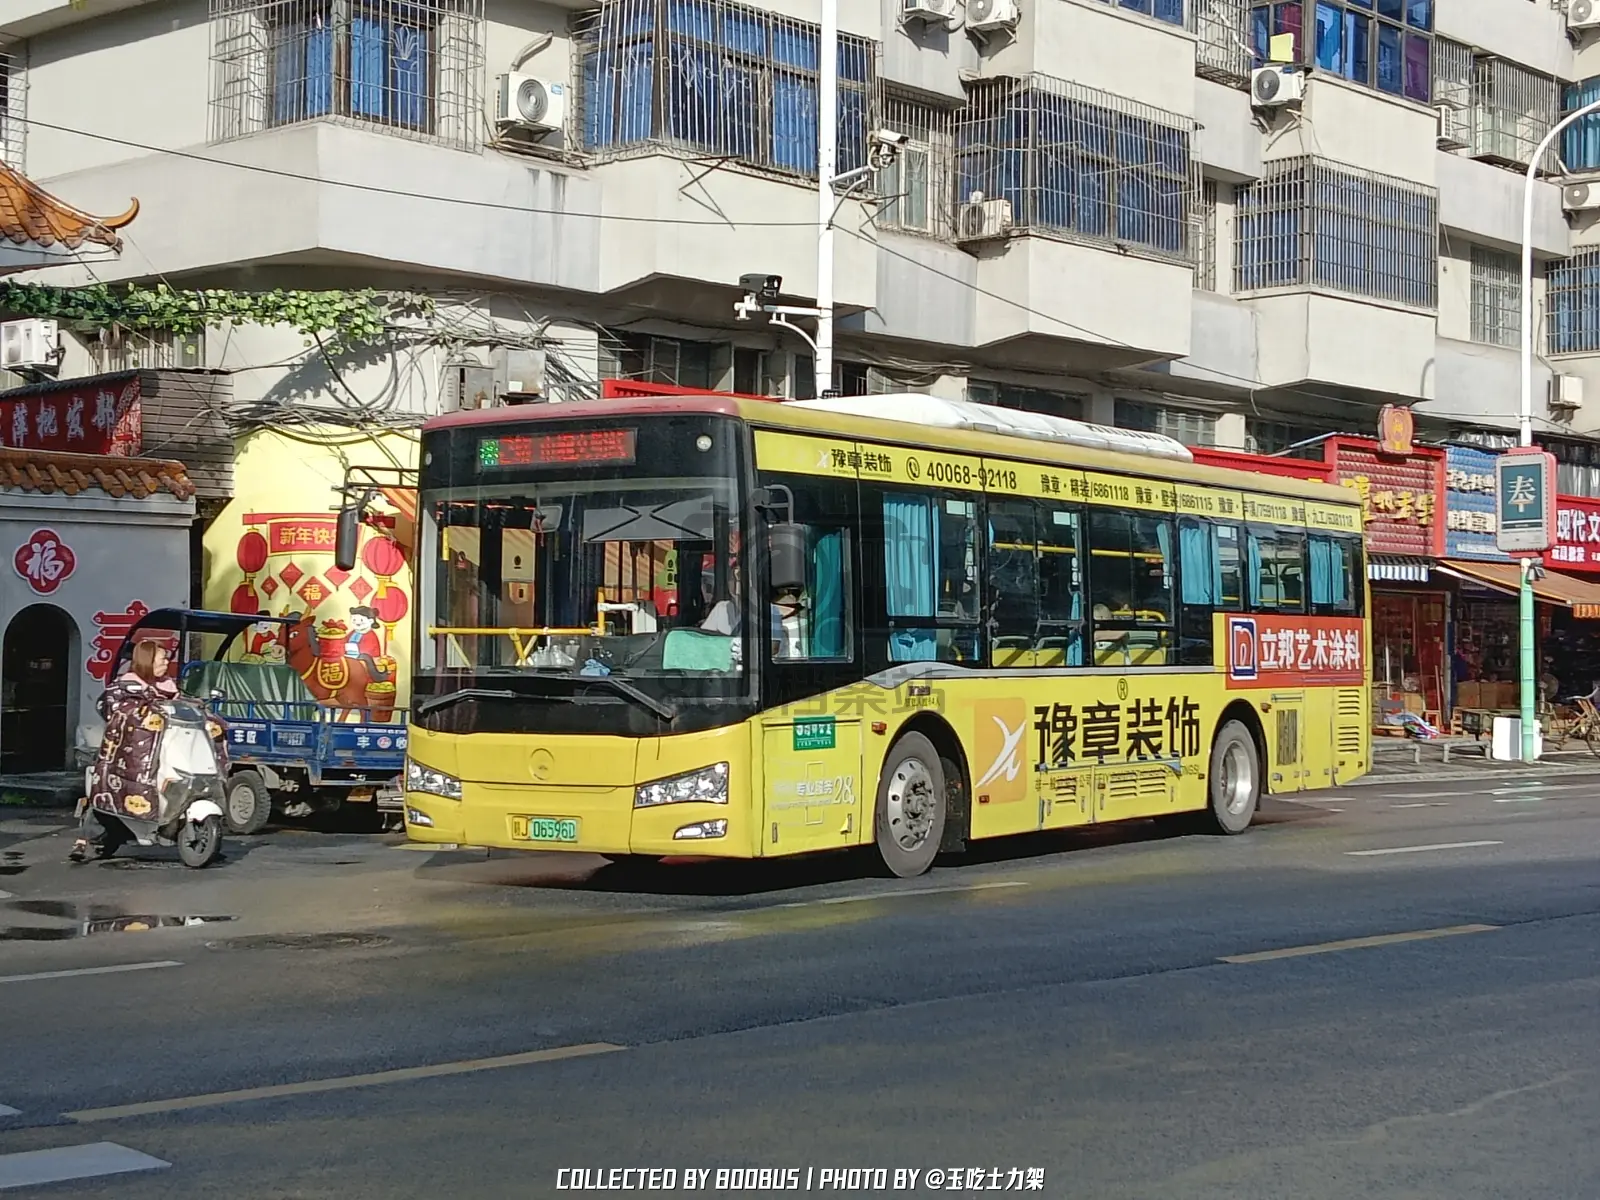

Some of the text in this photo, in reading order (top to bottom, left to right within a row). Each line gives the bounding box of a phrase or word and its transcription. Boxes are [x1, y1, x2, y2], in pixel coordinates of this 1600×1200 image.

[831, 448, 892, 473] 豫章装饰
[926, 462, 1017, 490] 40068-92118
[1506, 475, 1537, 513] 奉
[279, 526, 336, 546] 新年快
[25, 540, 64, 587] 福
[304, 583, 322, 601] 福
[1260, 628, 1361, 670] 立邦艺术涂料
[321, 662, 343, 682] 福
[1034, 695, 1200, 772] 豫章装饰
